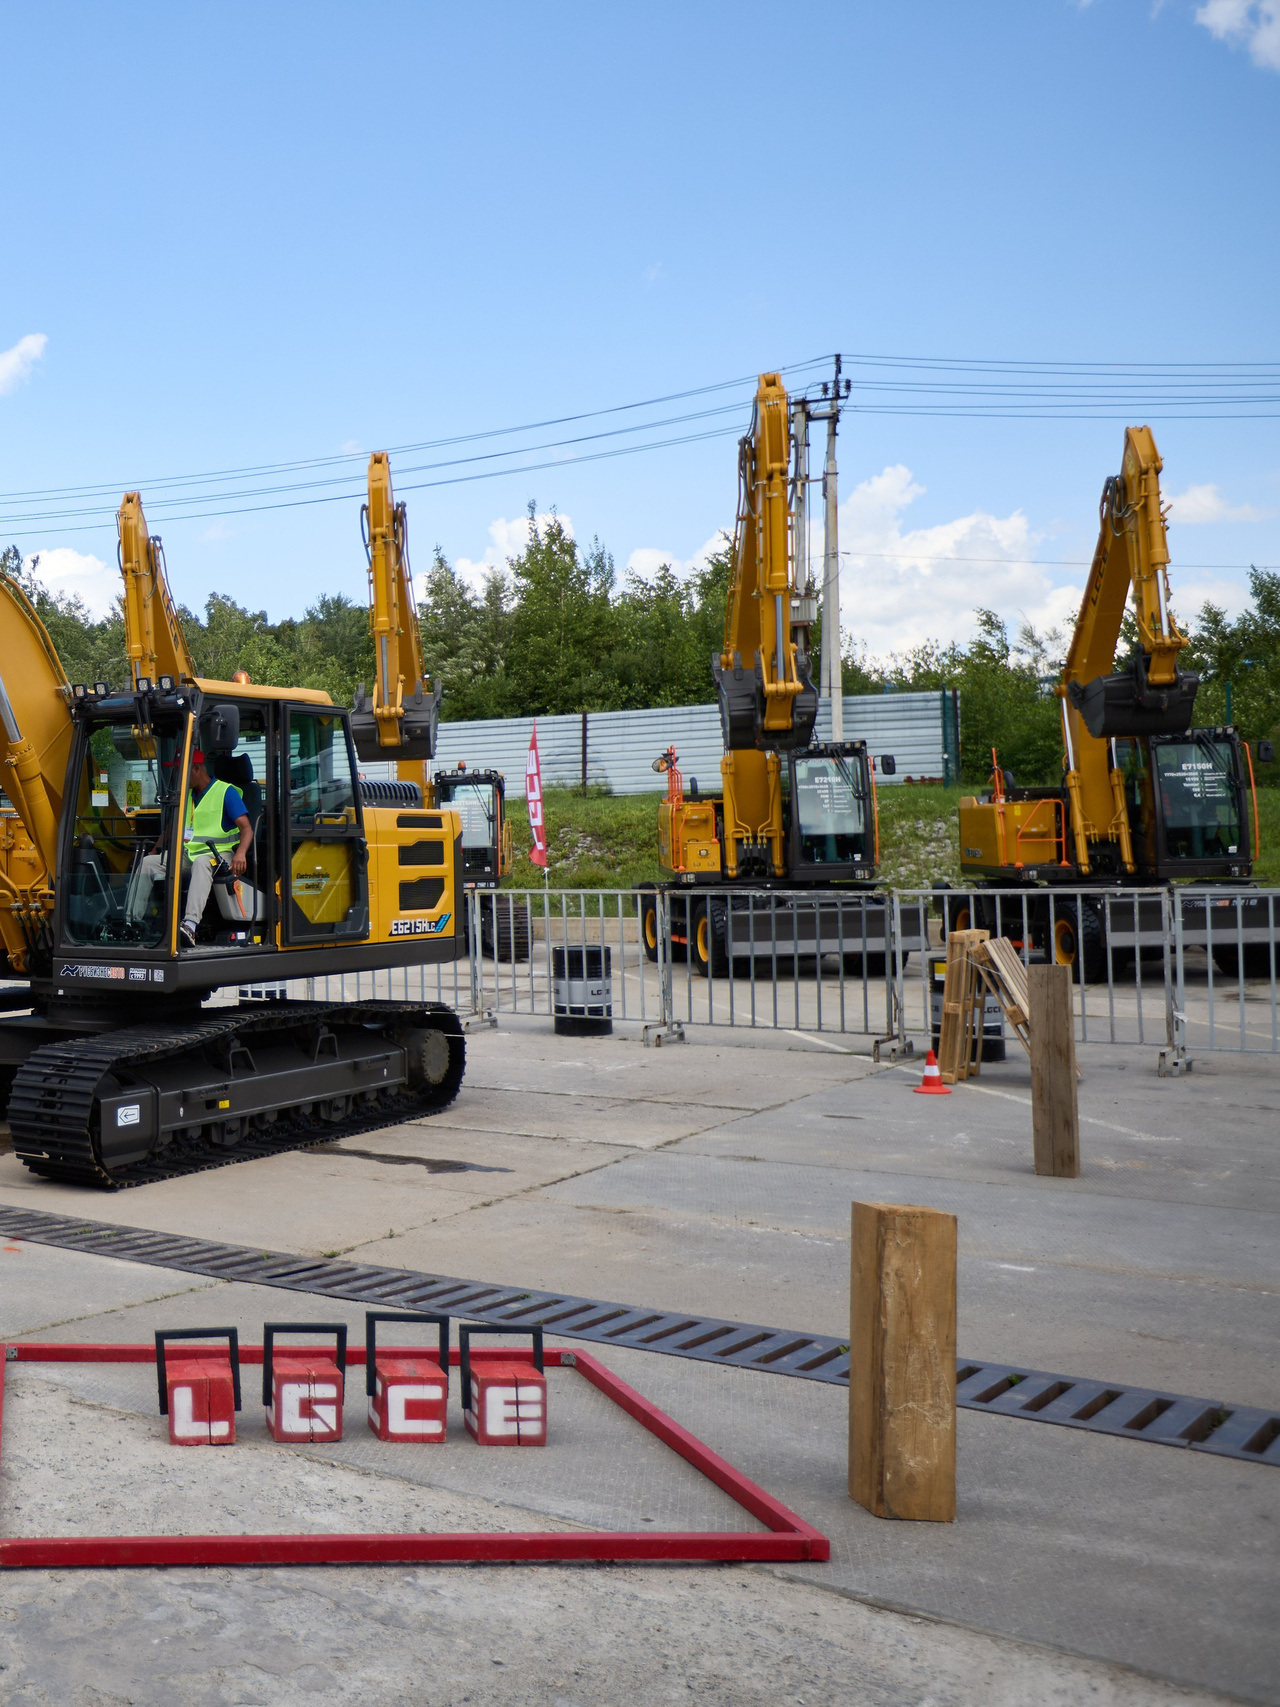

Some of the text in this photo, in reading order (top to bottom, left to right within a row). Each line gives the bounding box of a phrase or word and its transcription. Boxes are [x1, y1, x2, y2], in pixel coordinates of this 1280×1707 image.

[173, 1387, 228, 1436] L
[281, 1383, 337, 1433] G
[387, 1384, 443, 1434] C
[485, 1386, 542, 1436] E
